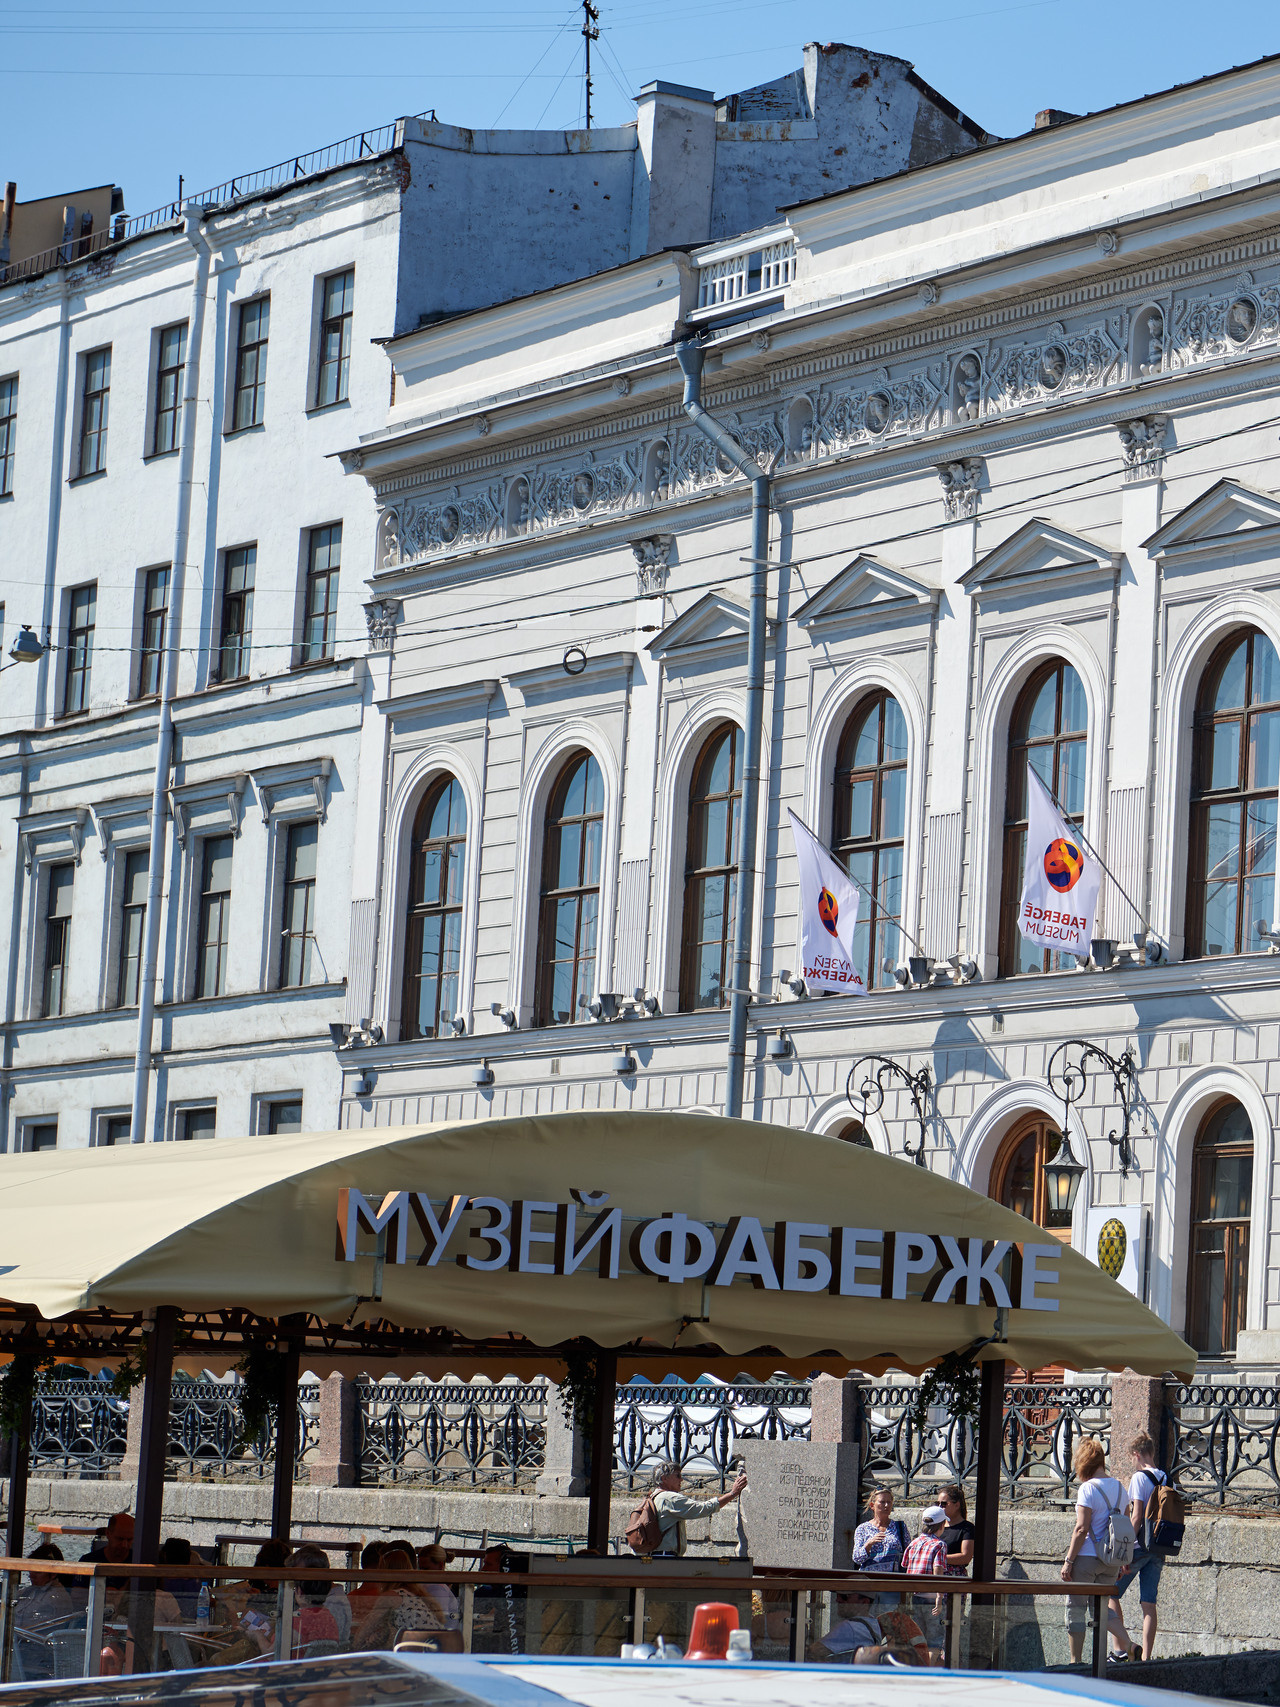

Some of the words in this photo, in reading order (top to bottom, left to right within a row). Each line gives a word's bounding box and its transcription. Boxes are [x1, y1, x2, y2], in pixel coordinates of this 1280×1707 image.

[336, 1188, 622, 1279] МУЗЕЙ
[629, 1212, 1061, 1312] ФАБЕРЖЕ
[780, 1463, 804, 1474] ЗДЕСЬ
[779, 1475, 791, 1485] ИЗ
[796, 1486, 831, 1498] ПРОРУБИ
[778, 1496, 805, 1508] БРАЛИ
[808, 1498, 830, 1509] ВОДУ
[796, 1509, 830, 1520] ЖИТЕЛИ
[777, 1519, 830, 1532] БЛОКАДНОГО
[776, 1530, 829, 1543] ЛЕНИНГРАДА
